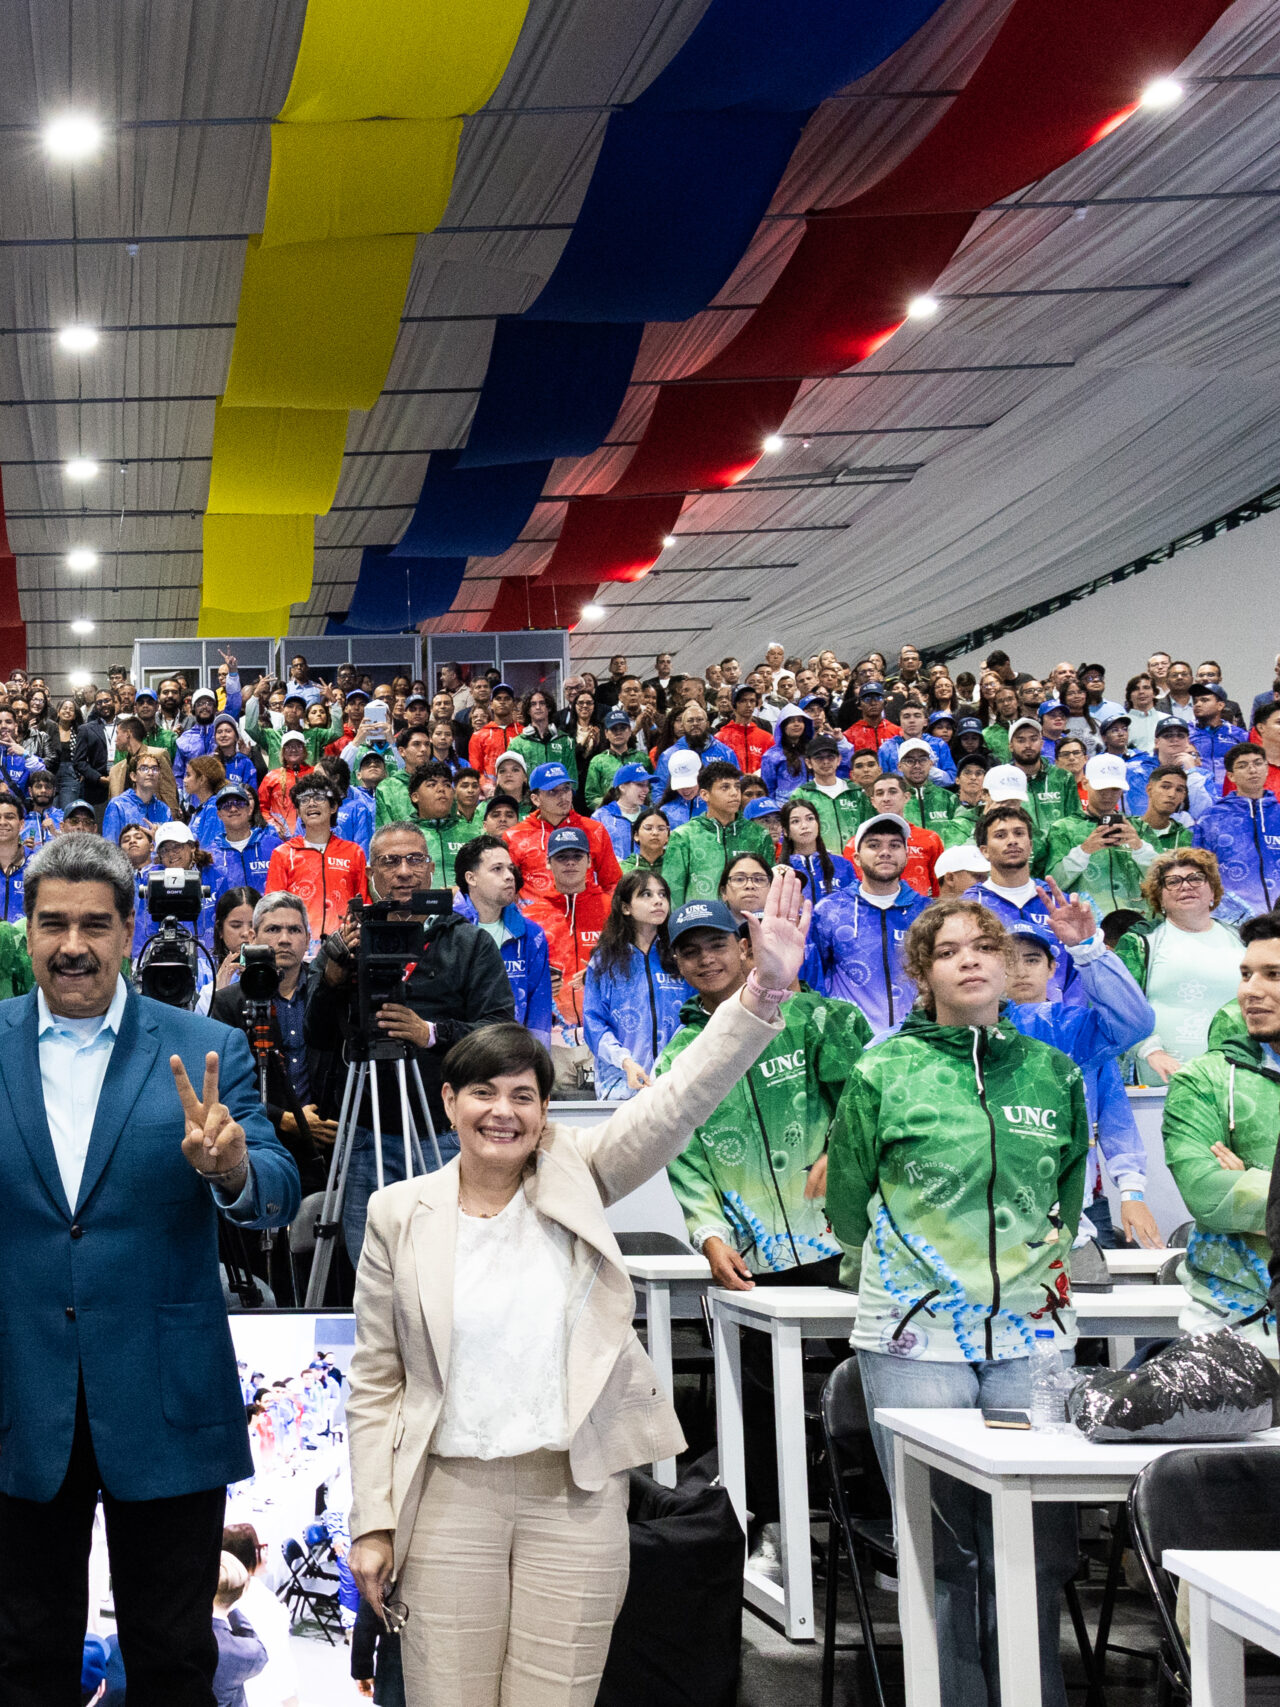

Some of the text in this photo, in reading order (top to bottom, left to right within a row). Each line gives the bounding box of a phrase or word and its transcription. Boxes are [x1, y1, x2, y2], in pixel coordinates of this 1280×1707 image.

[1038, 791, 1061, 800] UNC
[929, 811, 948, 819] UNC
[1264, 835, 1280, 845] UN
[328, 857, 351, 868] UNC
[171, 876, 177, 884] 7
[685, 904, 708, 914] UNC
[1030, 913, 1050, 926] UN
[581, 931, 602, 942] UN
[758, 1049, 806, 1078] UNC
[1000, 1105, 1057, 1130] UNC
